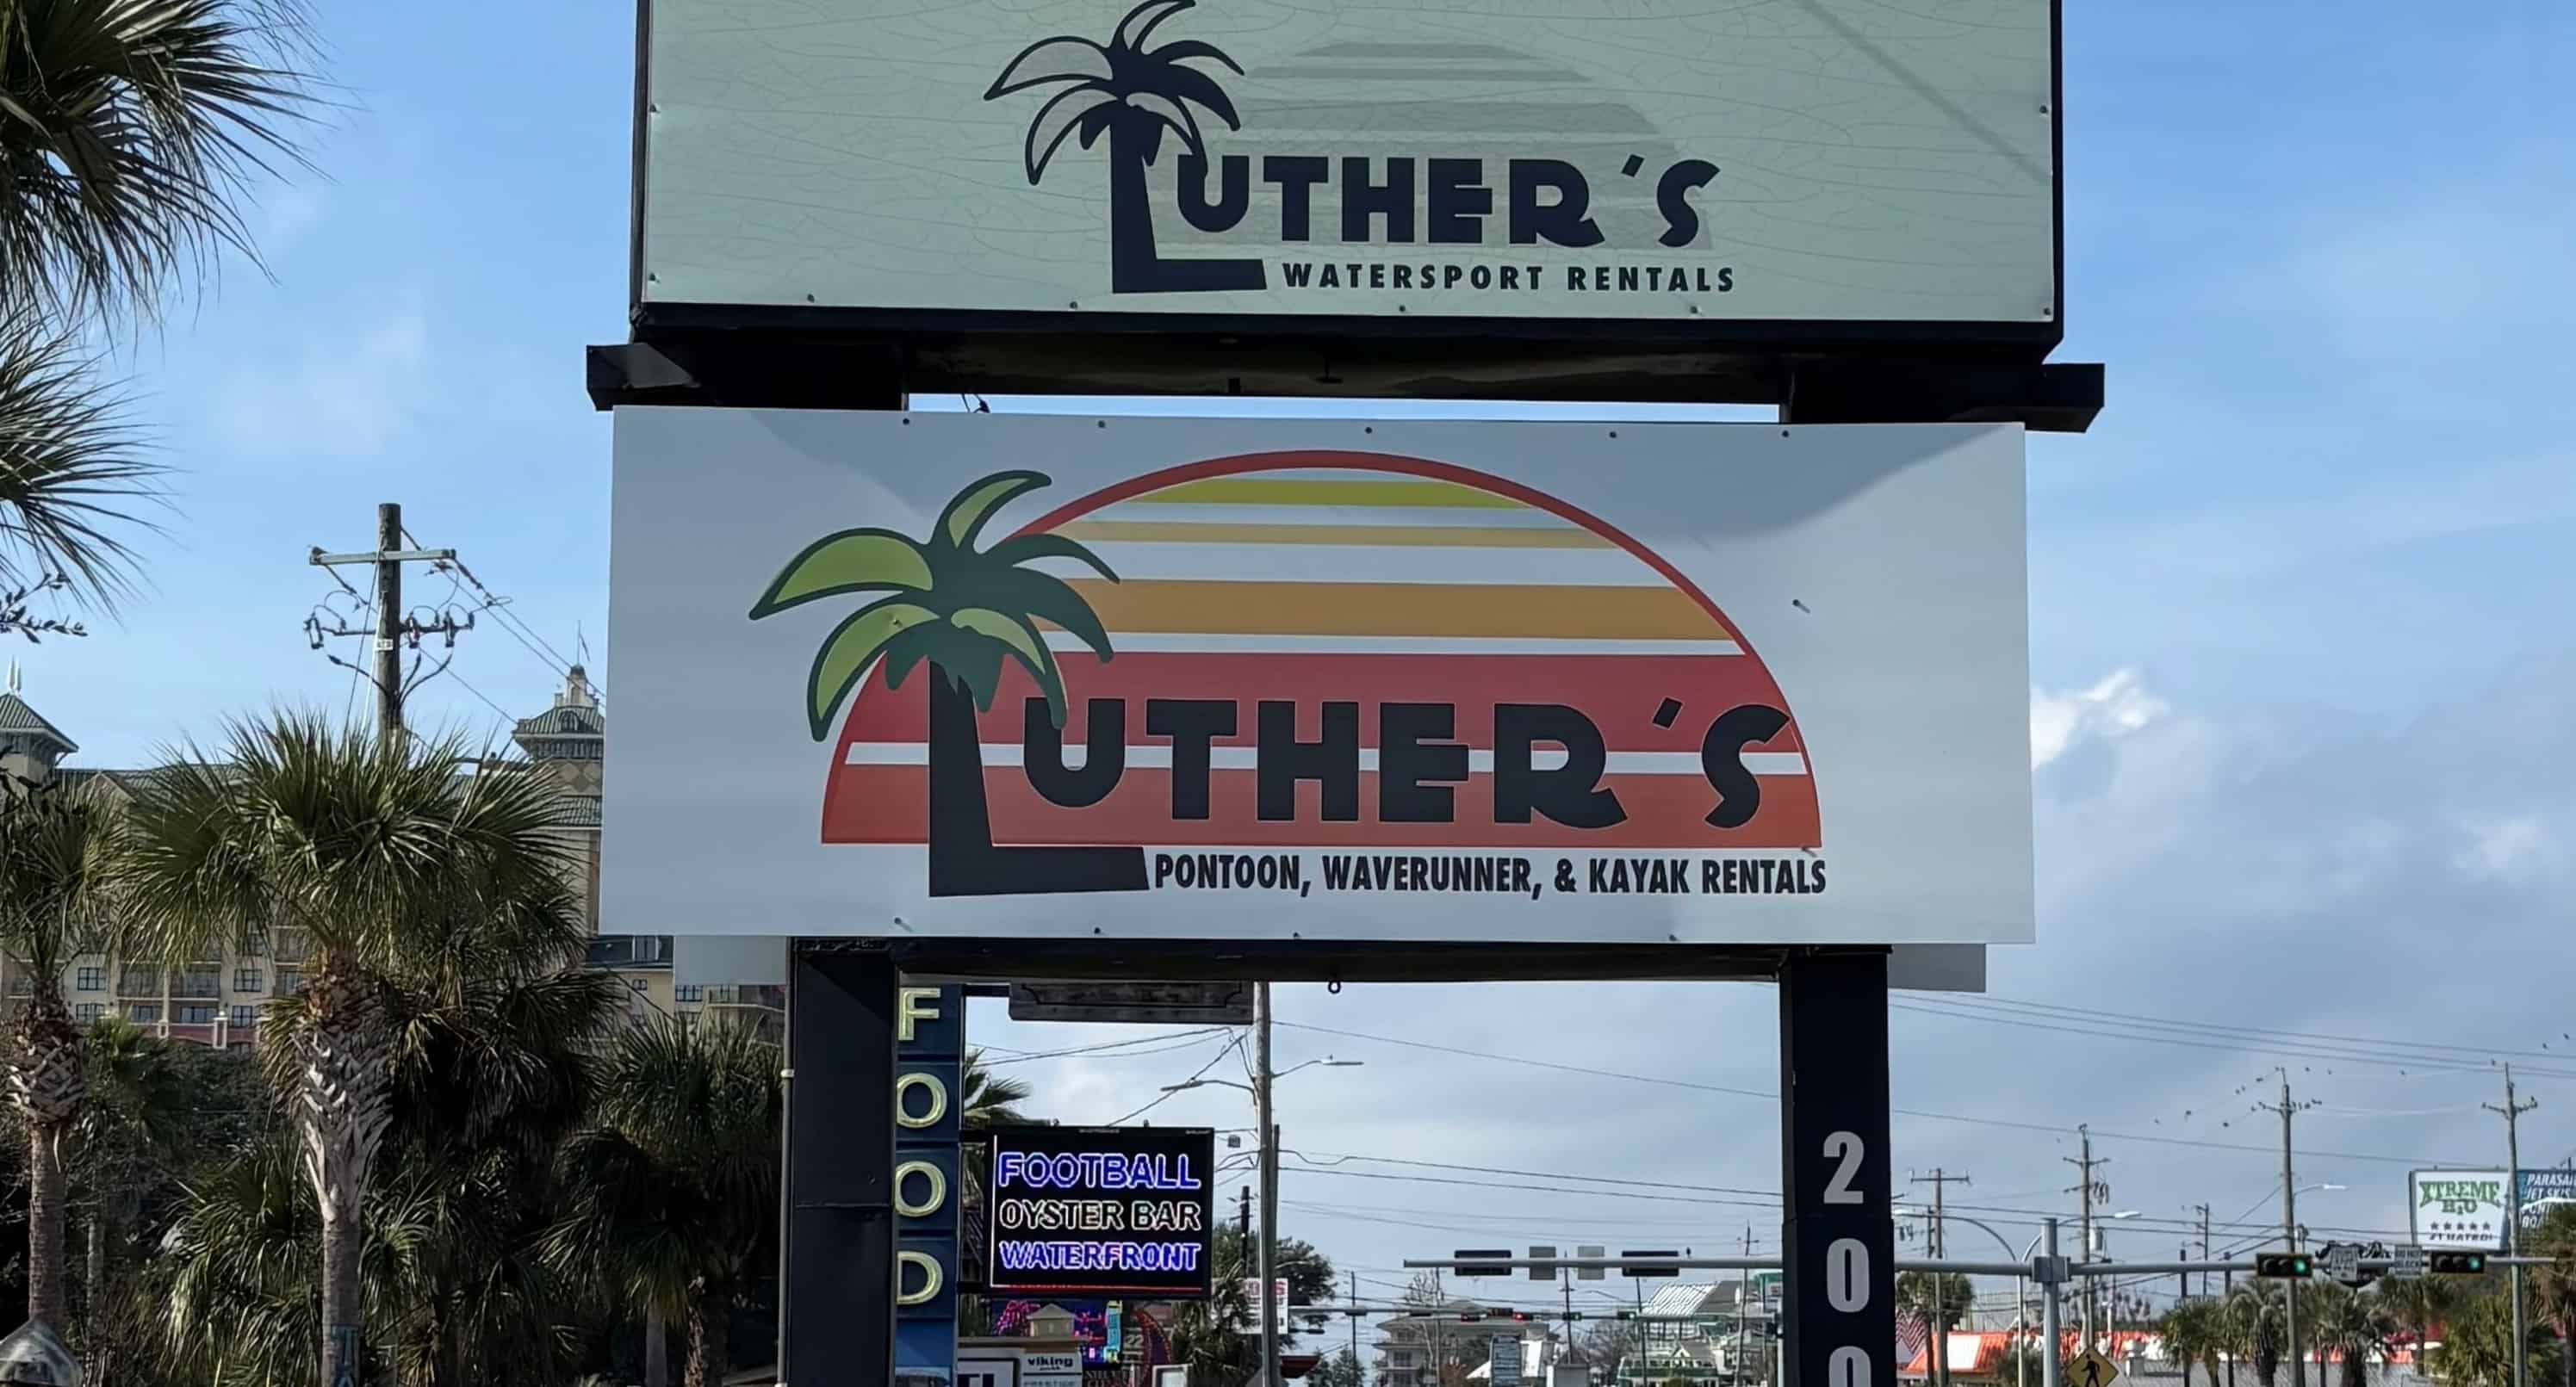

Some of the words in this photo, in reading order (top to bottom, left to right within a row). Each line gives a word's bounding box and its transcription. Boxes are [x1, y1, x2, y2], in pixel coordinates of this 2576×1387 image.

[1111, 125, 1721, 294] LUTHER'S
[1282, 262, 1543, 291] WATERSPORT
[1567, 266, 1734, 293] RENTALS
[929, 676, 1790, 896] LUTHER'S
[1155, 853, 1312, 898] PONTOON,
[1322, 855, 1542, 901] WAVERUNNER,
[1554, 858, 1577, 893] &
[1589, 858, 1691, 894] KAYAK
[1702, 859, 1827, 895] RENTALS
[894, 987, 947, 1306] FOOD
[998, 1151, 1201, 1189] FOOTBALL
[2418, 1180, 2501, 1208] XTREME
[999, 1198, 1125, 1229] OYSTER
[1131, 1200, 1201, 1230] BAR
[998, 1241, 1201, 1271] WATERFRONT
